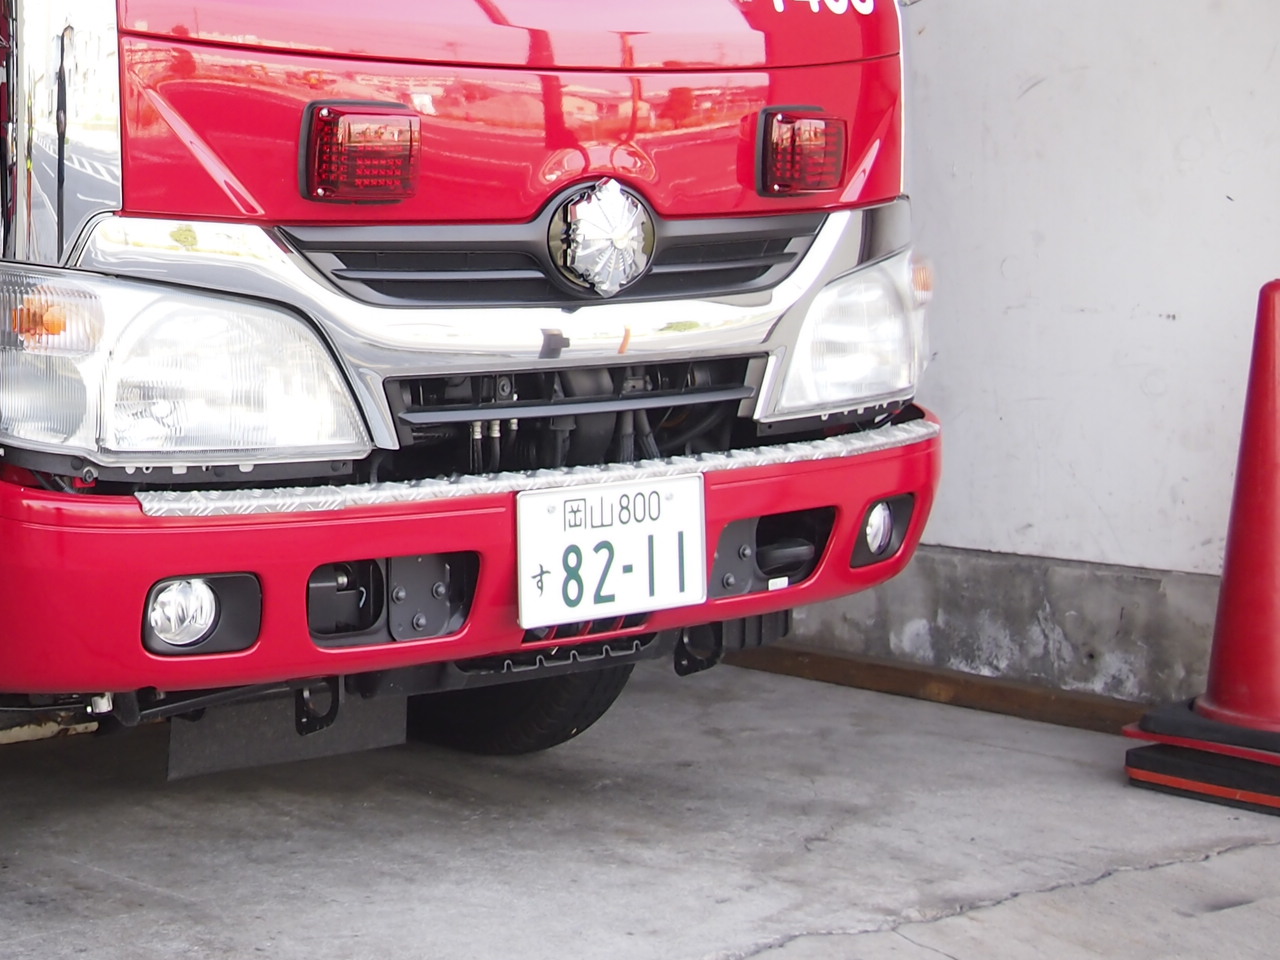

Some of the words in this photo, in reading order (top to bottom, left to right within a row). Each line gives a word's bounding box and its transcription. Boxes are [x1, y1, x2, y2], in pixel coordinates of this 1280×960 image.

[563, 490, 661, 532] 岡山800
[531, 563, 551, 597] す
[561, 531, 686, 608] 82-11
